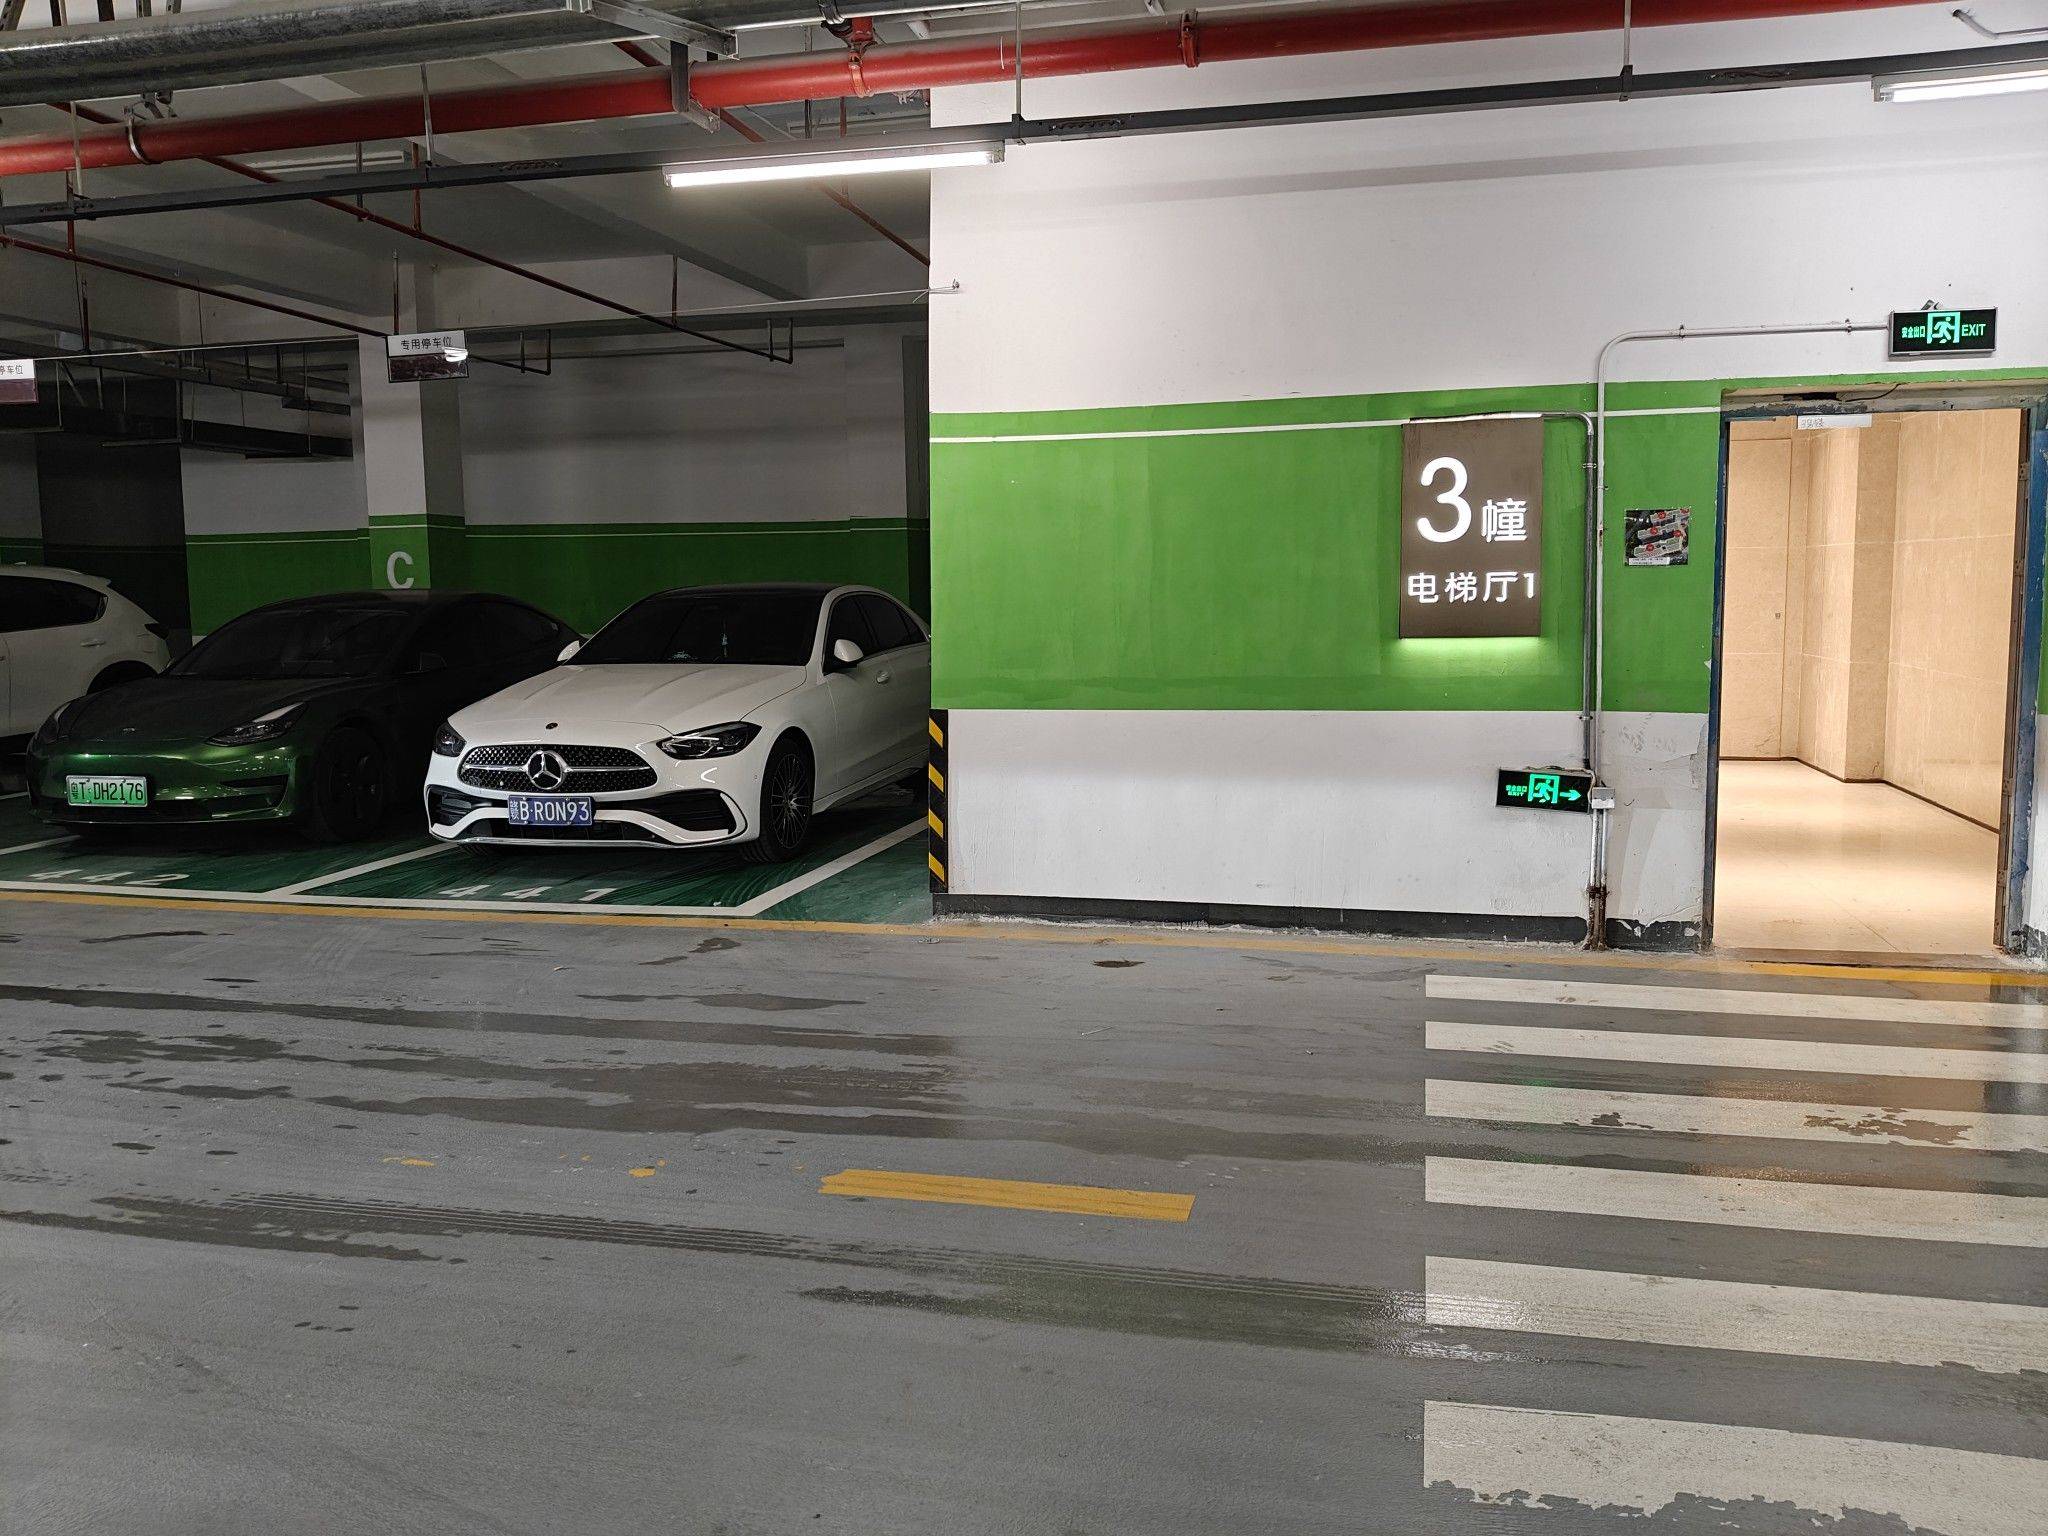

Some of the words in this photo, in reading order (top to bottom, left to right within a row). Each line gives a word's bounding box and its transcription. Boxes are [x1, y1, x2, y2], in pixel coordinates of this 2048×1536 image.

[1902, 326, 1926, 339] 安全出口
[1961, 323, 1986, 337] EXIT
[401, 336, 452, 350] 专用停车位
[1416, 456, 1528, 543] 3幢
[386, 551, 415, 589] C
[1407, 572, 1535, 604] 电梯厅1
[28, 868, 191, 887] 442
[437, 884, 619, 902] 441
